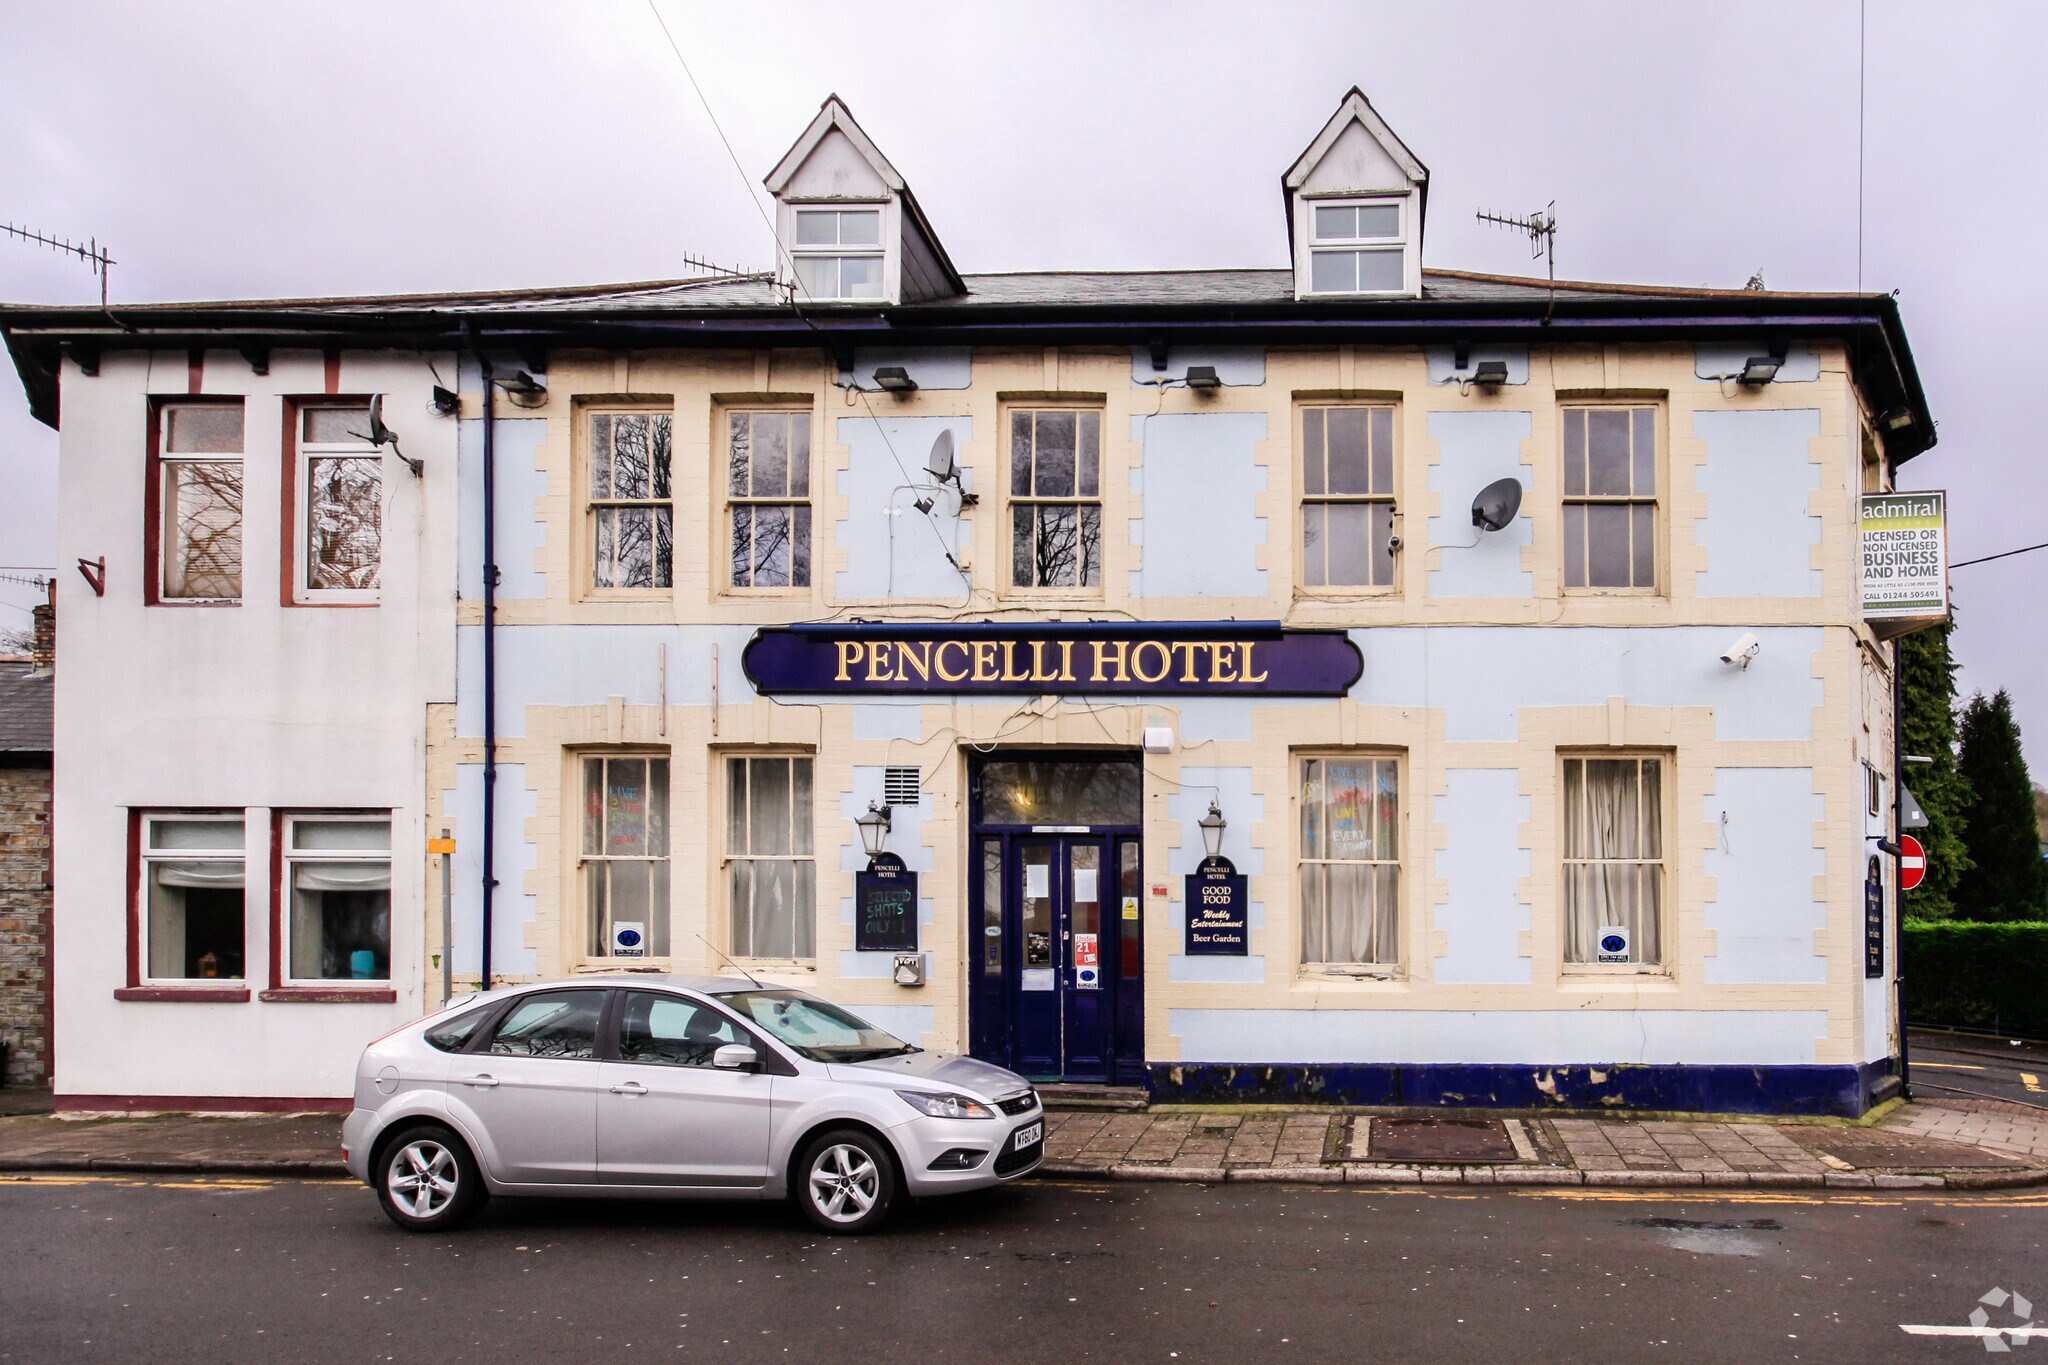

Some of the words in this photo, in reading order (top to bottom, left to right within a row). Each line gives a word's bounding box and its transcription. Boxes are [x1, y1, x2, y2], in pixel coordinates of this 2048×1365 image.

[1863, 499, 1937, 519] admiral
[1863, 530, 1916, 542] LICENSED
[1920, 530, 1937, 540] OR
[1863, 543, 1888, 552] NON
[1891, 541, 1938, 551] LICENSED
[1863, 551, 1938, 566] BUSINESS
[1863, 567, 1893, 579] AND
[1898, 565, 1938, 577] HOME
[1910, 590, 1939, 598] 505491
[834, 640, 1077, 682] PENCELLI
[1089, 640, 1269, 683] HOTEL
[608, 785, 640, 801] LIVE
[1333, 829, 1365, 842] EVERY
[1202, 886, 1231, 895] GOOD
[1203, 895, 1231, 904] FOOD
[867, 903, 904, 919] SHOTS
[1203, 909, 1231, 920] Weekly
[1191, 918, 1243, 928] Entertainment
[1076, 935, 1096, 943] Under
[1193, 933, 1211, 942] Beer
[1212, 933, 1241, 943] Garden
[1076, 942, 1090, 953] 21
